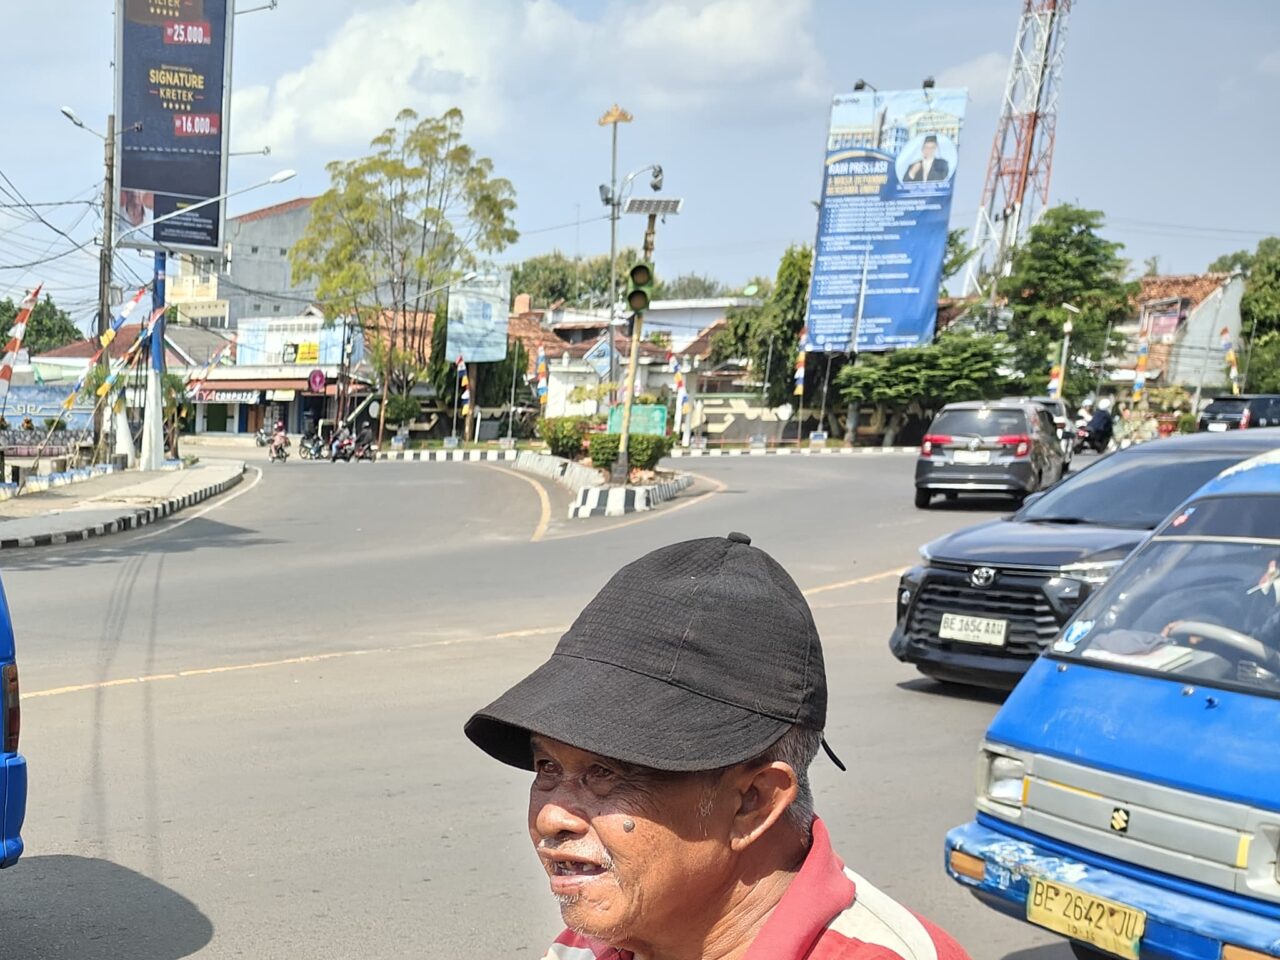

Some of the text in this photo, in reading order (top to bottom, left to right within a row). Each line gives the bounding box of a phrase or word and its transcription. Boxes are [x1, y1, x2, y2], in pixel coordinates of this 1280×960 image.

[174, 24, 203, 43] 25.000
[149, 69, 204, 89] SIGNATURE
[160, 88, 194, 101] KRETEK
[182, 115, 210, 134] 16.000
[943, 617, 956, 630] BE
[1033, 881, 1138, 941] BE 2642 JU
